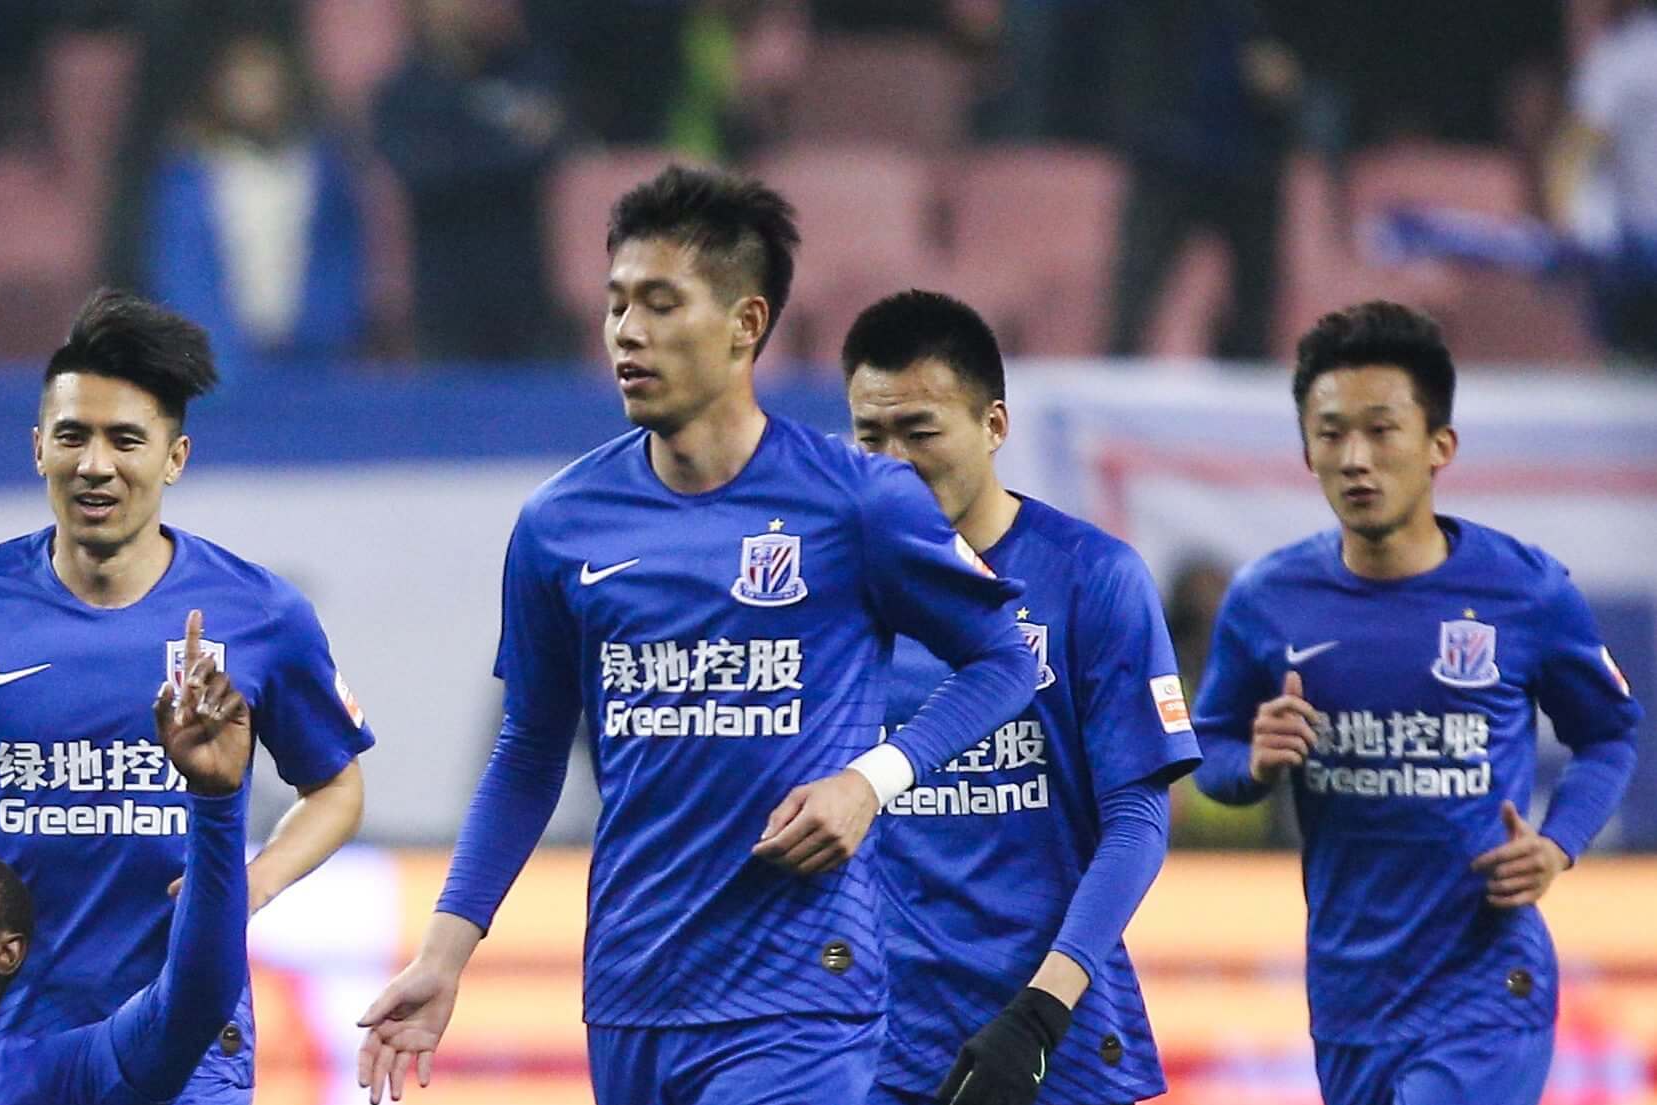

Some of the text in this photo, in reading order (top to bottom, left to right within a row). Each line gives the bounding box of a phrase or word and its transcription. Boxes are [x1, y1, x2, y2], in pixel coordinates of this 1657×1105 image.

[599, 637, 804, 694] 绿地控股
[604, 699, 802, 737] Greenland
[876, 774, 1049, 816] eenland
[1305, 759, 1492, 798] Greenland
